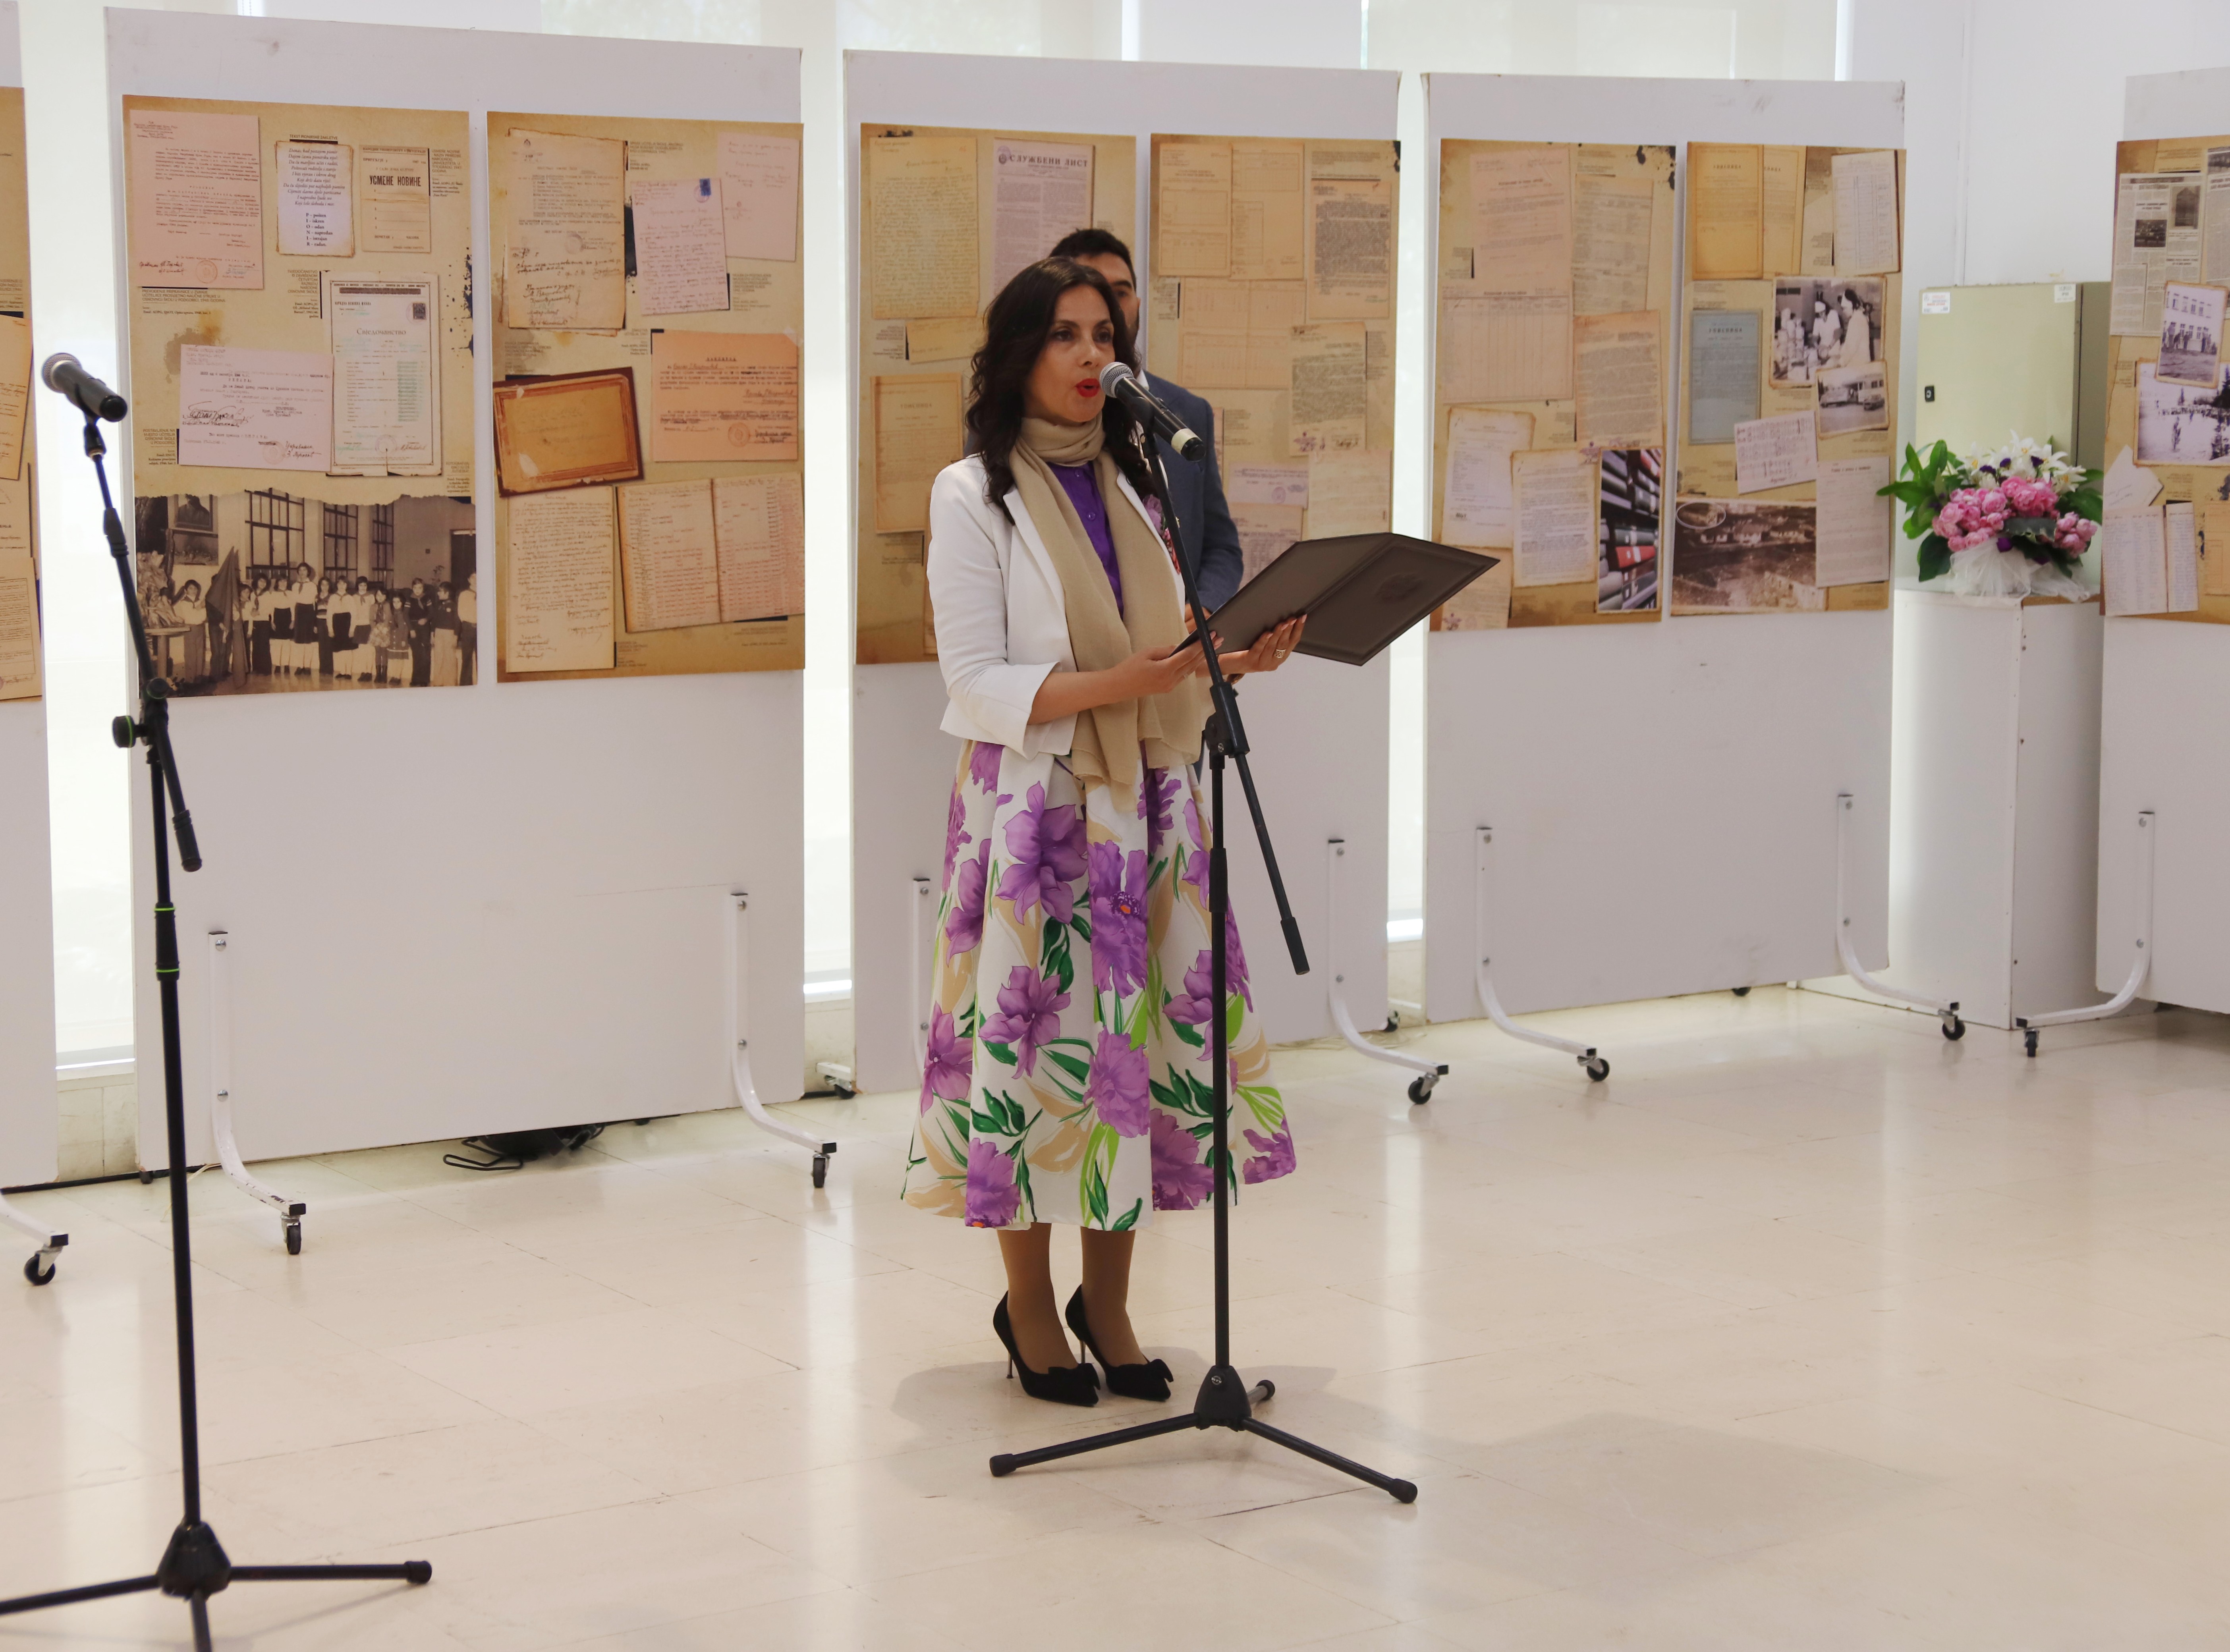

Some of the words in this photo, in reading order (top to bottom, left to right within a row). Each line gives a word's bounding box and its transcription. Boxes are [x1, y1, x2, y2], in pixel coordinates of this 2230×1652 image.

[1010, 154, 1060, 164] СЛУЖБЕНИ
[1065, 158, 1087, 167] ЛИСТ
[369, 175, 394, 185] УСМЕНЕ
[398, 176, 421, 187] НОВИНЕ
